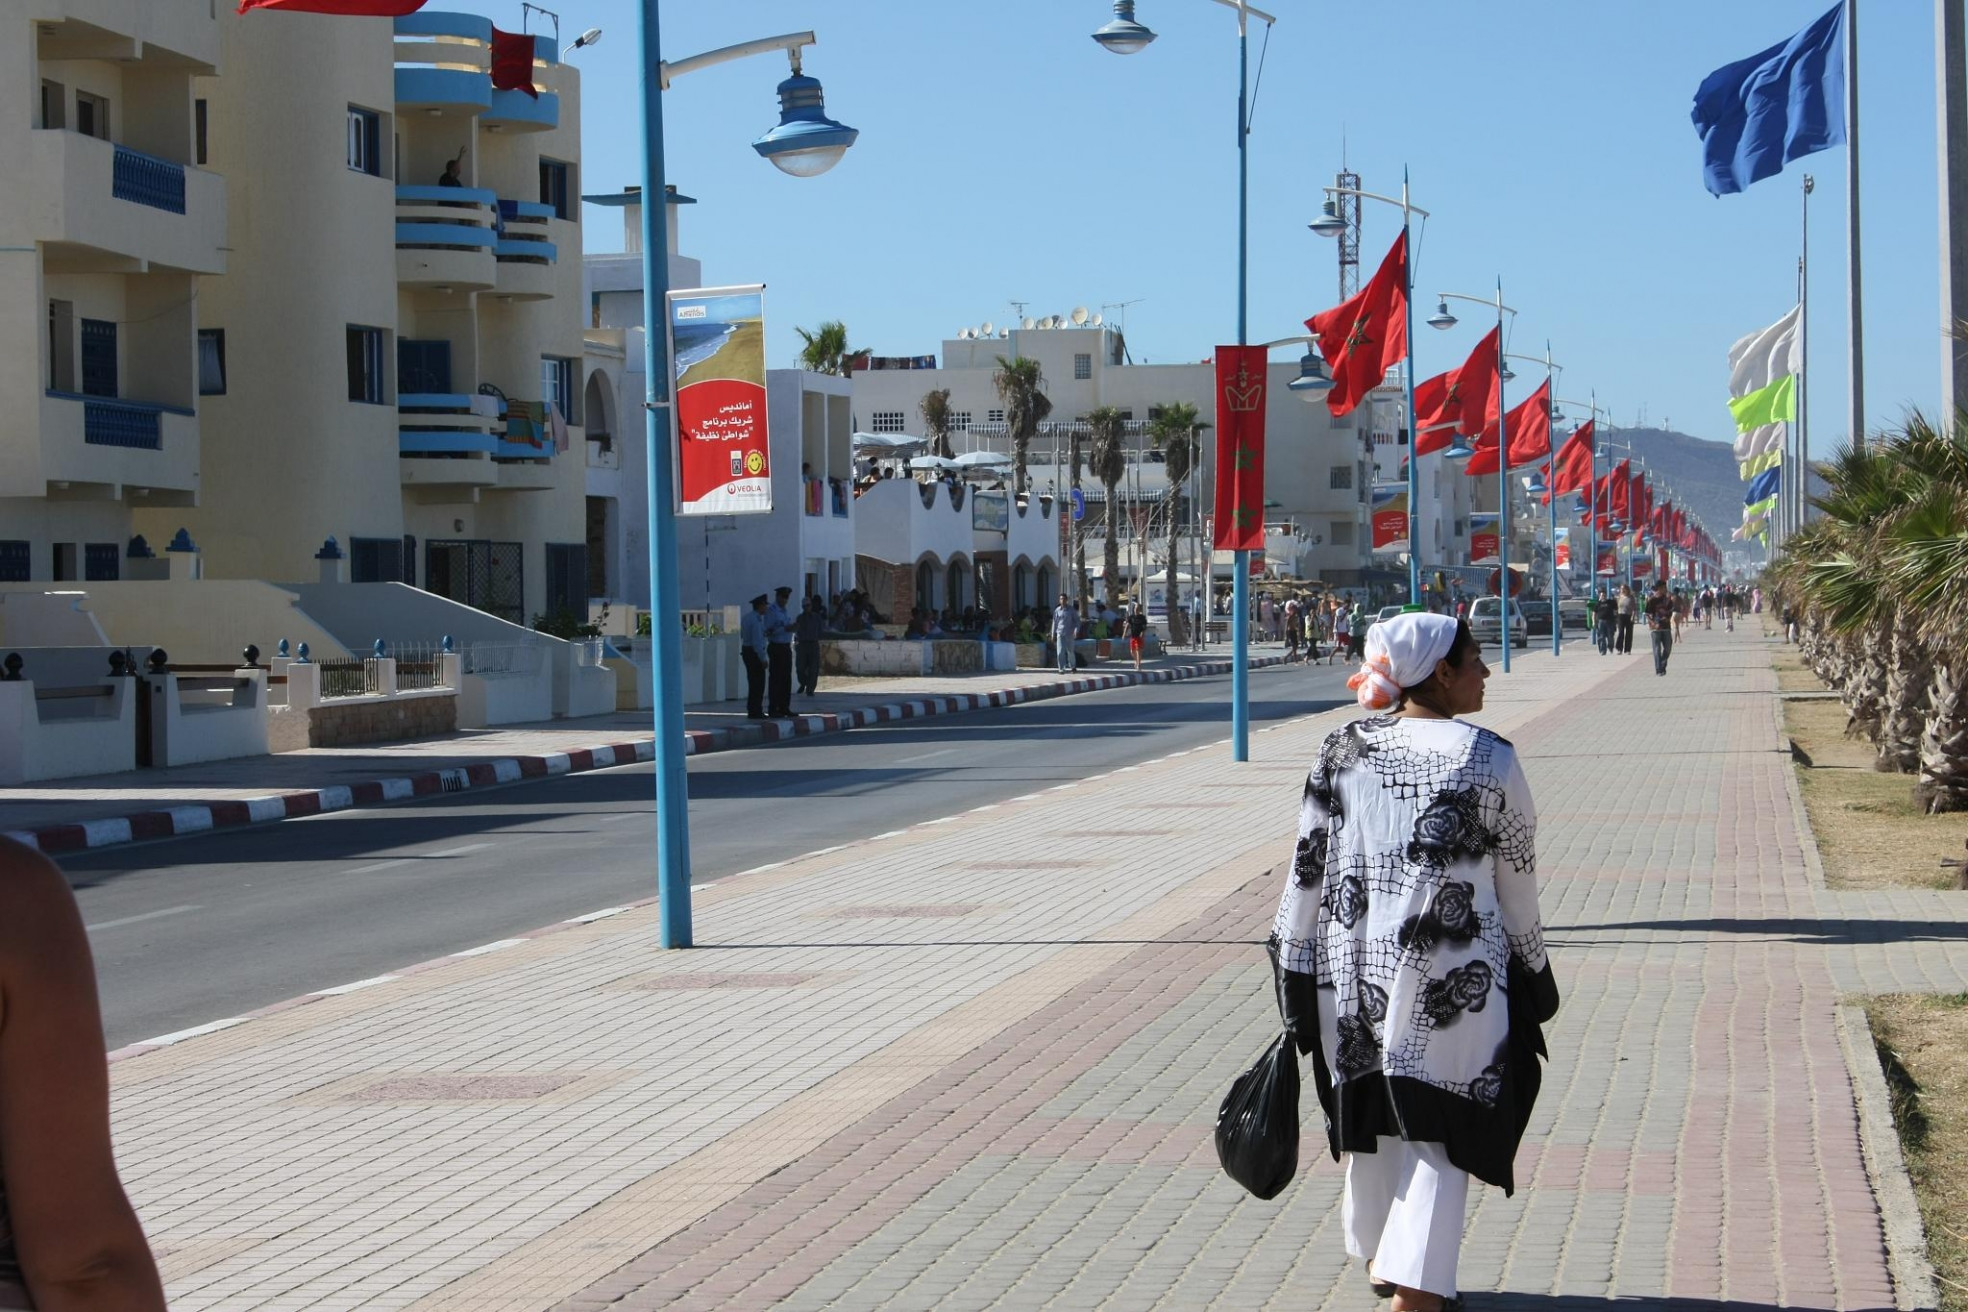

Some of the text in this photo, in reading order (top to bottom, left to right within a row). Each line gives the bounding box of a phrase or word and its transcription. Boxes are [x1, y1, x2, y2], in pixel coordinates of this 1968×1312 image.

[719, 400, 752, 413] أمانديس
[702, 415, 753, 429] شريك برنامج
[737, 485, 762, 493] VEOLIA
